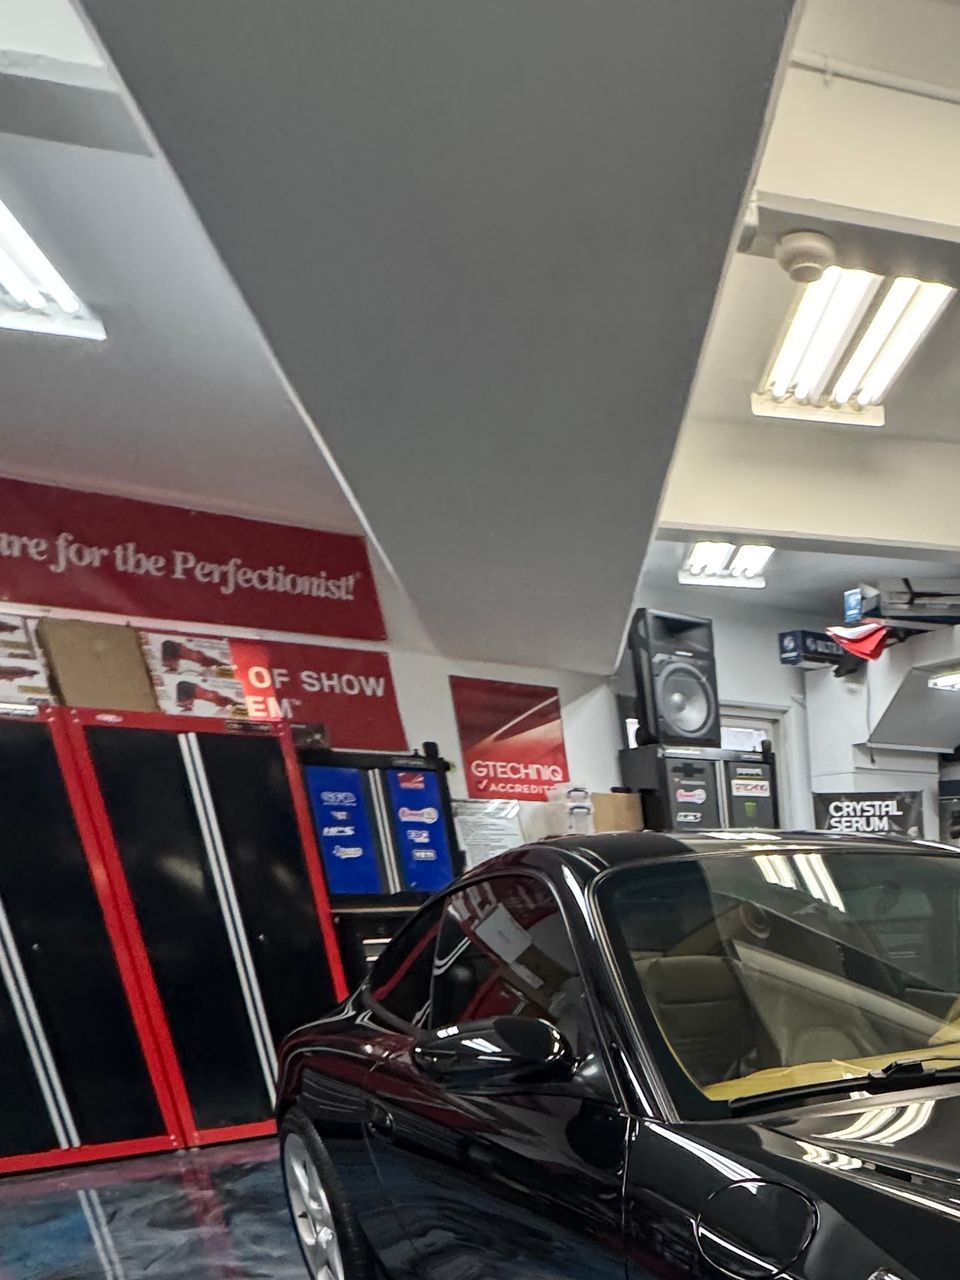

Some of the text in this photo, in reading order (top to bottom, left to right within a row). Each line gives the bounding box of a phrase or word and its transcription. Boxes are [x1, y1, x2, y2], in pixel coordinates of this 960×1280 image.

[50, 532, 109, 573] for
[113, 542, 166, 576] the
[247, 666, 385, 697] OF SHOW
[828, 800, 903, 817] CRYSTAL
[829, 816, 890, 832] SERUM
